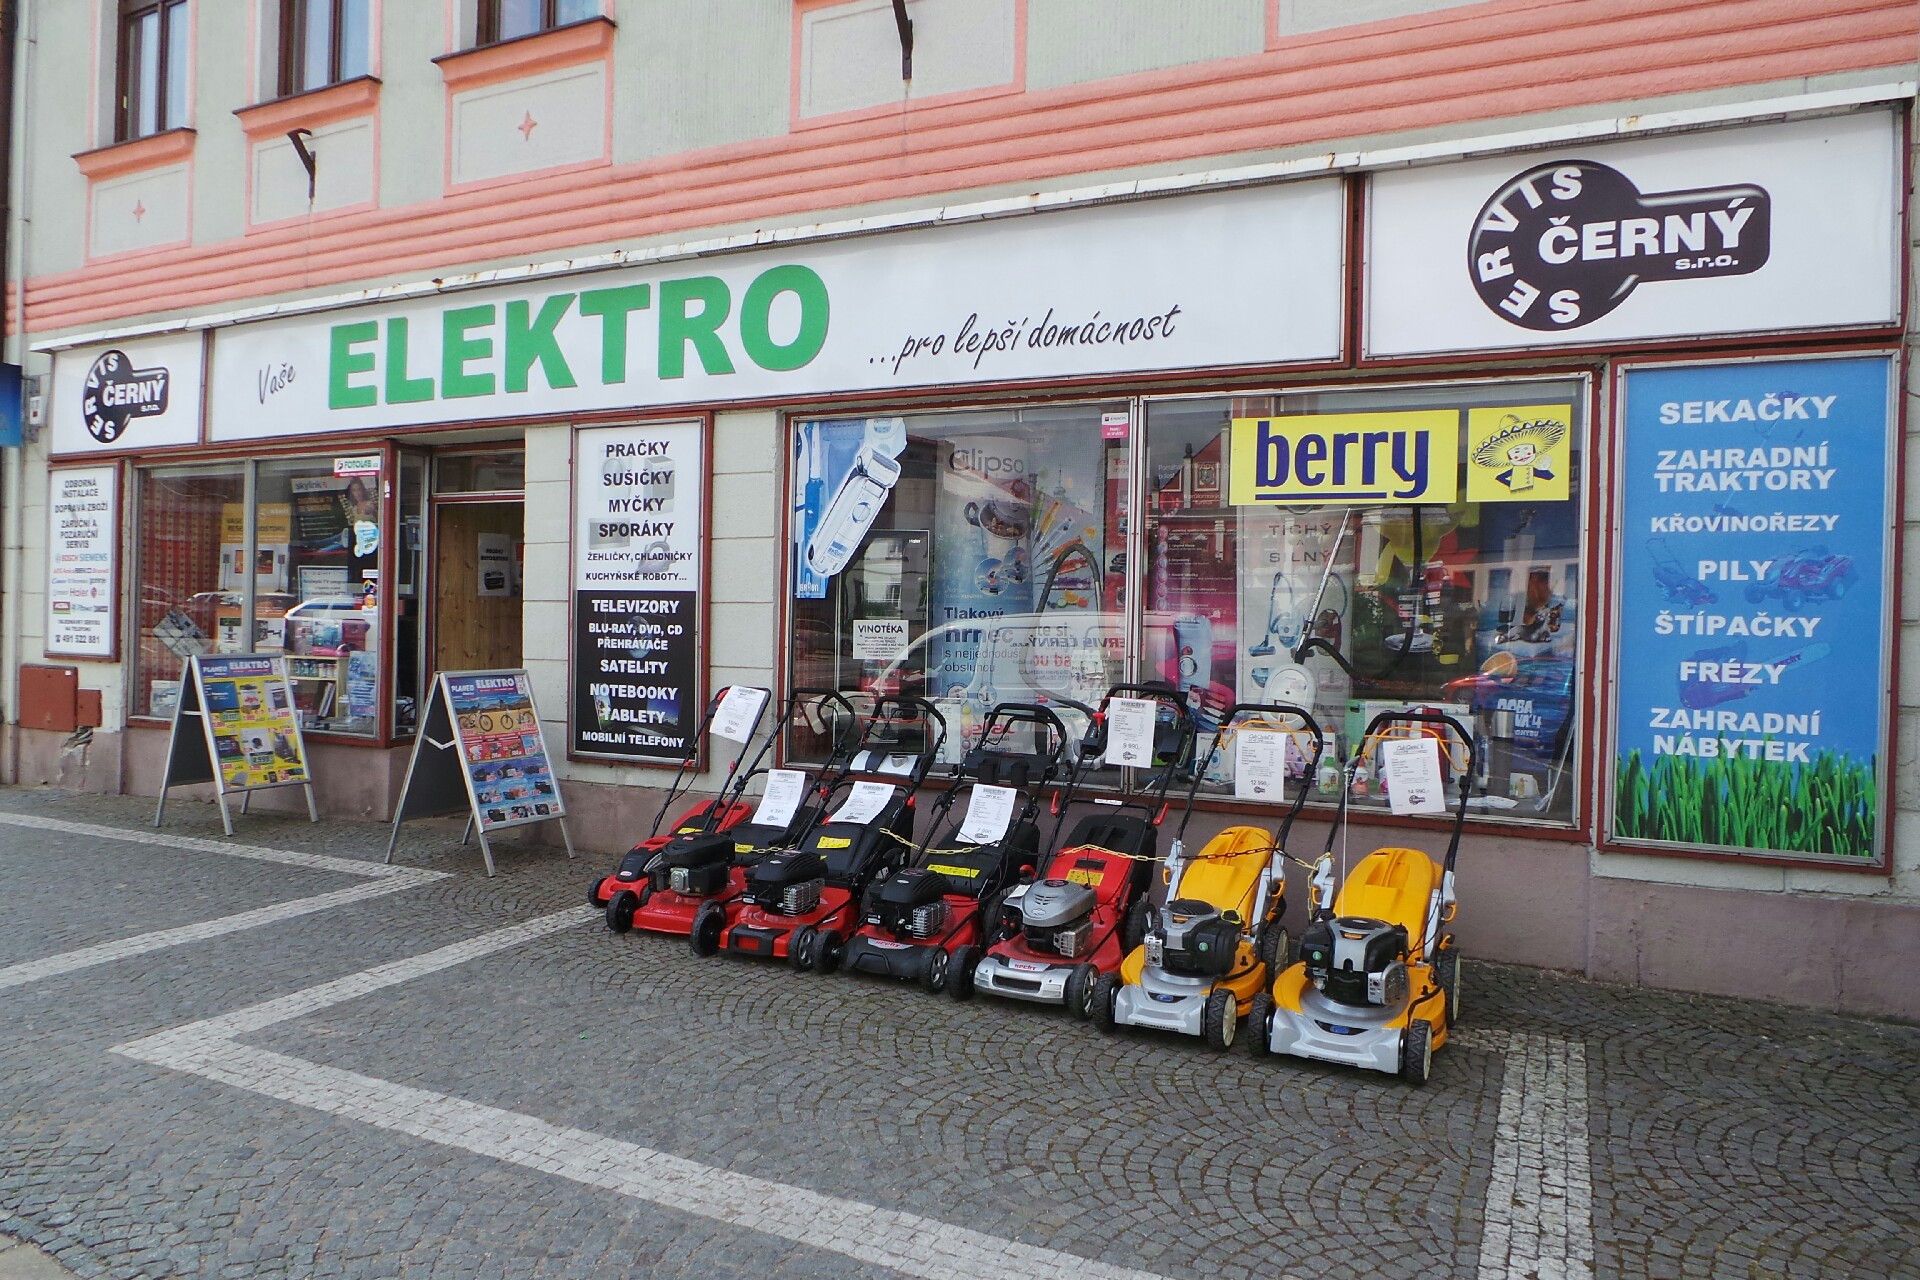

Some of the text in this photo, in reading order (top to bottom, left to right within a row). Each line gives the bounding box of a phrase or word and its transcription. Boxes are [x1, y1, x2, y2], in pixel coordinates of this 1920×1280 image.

[1538, 197, 1755, 265] ČERNÝ
[1477, 166, 1582, 324] SERVIS
[1674, 254, 1739, 271] s.r.o.
[258, 362, 296, 406] Vaše
[328, 264, 830, 410] ELEKTRO
[953, 312, 1029, 370] lepší
[1027, 303, 1182, 349] domácnost
[84, 354, 119, 440] SERVIS
[102, 374, 166, 407] ČERNÝ
[1658, 392, 1838, 425] SEKAČKY
[605, 439, 671, 458] PRAČKY
[1656, 441, 1829, 471] ZAHRADNÍ
[1255, 420, 1430, 499] berry
[603, 468, 674, 487] SUŠIČKY
[1653, 468, 1838, 493] TRAKTORY
[608, 495, 666, 513] MYČKY
[598, 519, 675, 538] SPORÁKY
[1650, 511, 1840, 533] KŘOVINOŘEZY
[80, 553, 108, 561] SIEMENS
[634, 550, 693, 562] CHLADNIČKY
[585, 570, 640, 581] KUCHYŇSKÉ
[1697, 560, 1774, 581] PILY
[799, 581, 819, 592] BRAUN
[591, 599, 680, 614] TELEVIZORY
[943, 606, 1004, 621] Tlakový
[588, 622, 683, 637] BLU-RAY, DVD, CD
[857, 622, 904, 634] VINOTÉKA
[1654, 609, 1822, 638] ŠTÍPAČKY
[597, 637, 669, 651] PŘEHRÁVAČE
[228, 660, 271, 669] ELEKTRO
[600, 659, 669, 675] SATELITY
[1679, 658, 1787, 685] FRÉZY
[475, 677, 515, 688] ELEKTRO
[589, 682, 679, 701] NOTEBOOKY
[600, 708, 666, 724] TABLETY
[1649, 707, 1821, 736] ZAHRADNÍ
[582, 730, 685, 748] MOBILNÍ TELEFONY
[1653, 731, 1811, 764] NÁBYTEK
